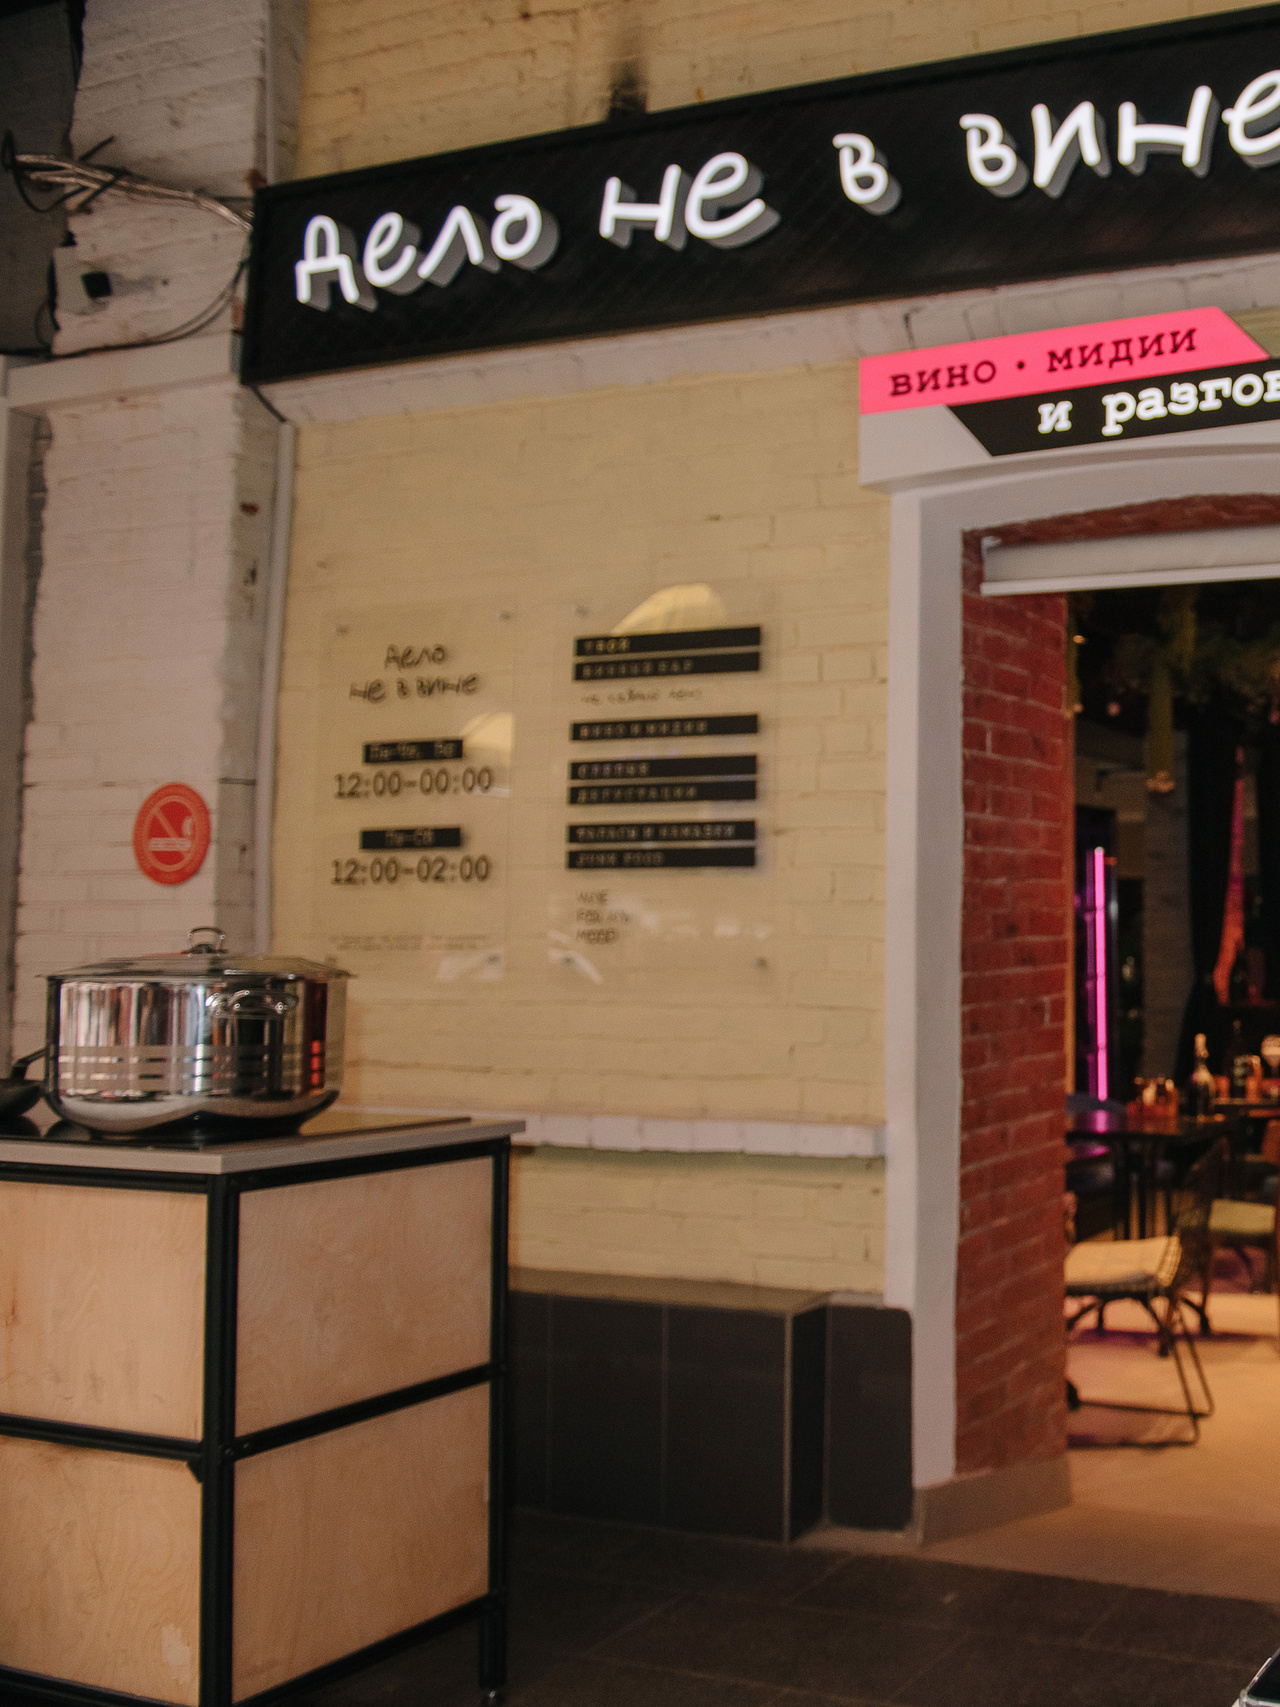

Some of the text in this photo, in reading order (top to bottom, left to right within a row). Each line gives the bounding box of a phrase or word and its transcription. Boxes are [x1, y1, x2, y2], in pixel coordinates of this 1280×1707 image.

[598, 150, 767, 243] не
[831, 131, 891, 207] в
[1037, 400, 1073, 433] и
[334, 766, 493, 798] 12:00-00:00
[331, 854, 490, 885] 12:00-02:00
